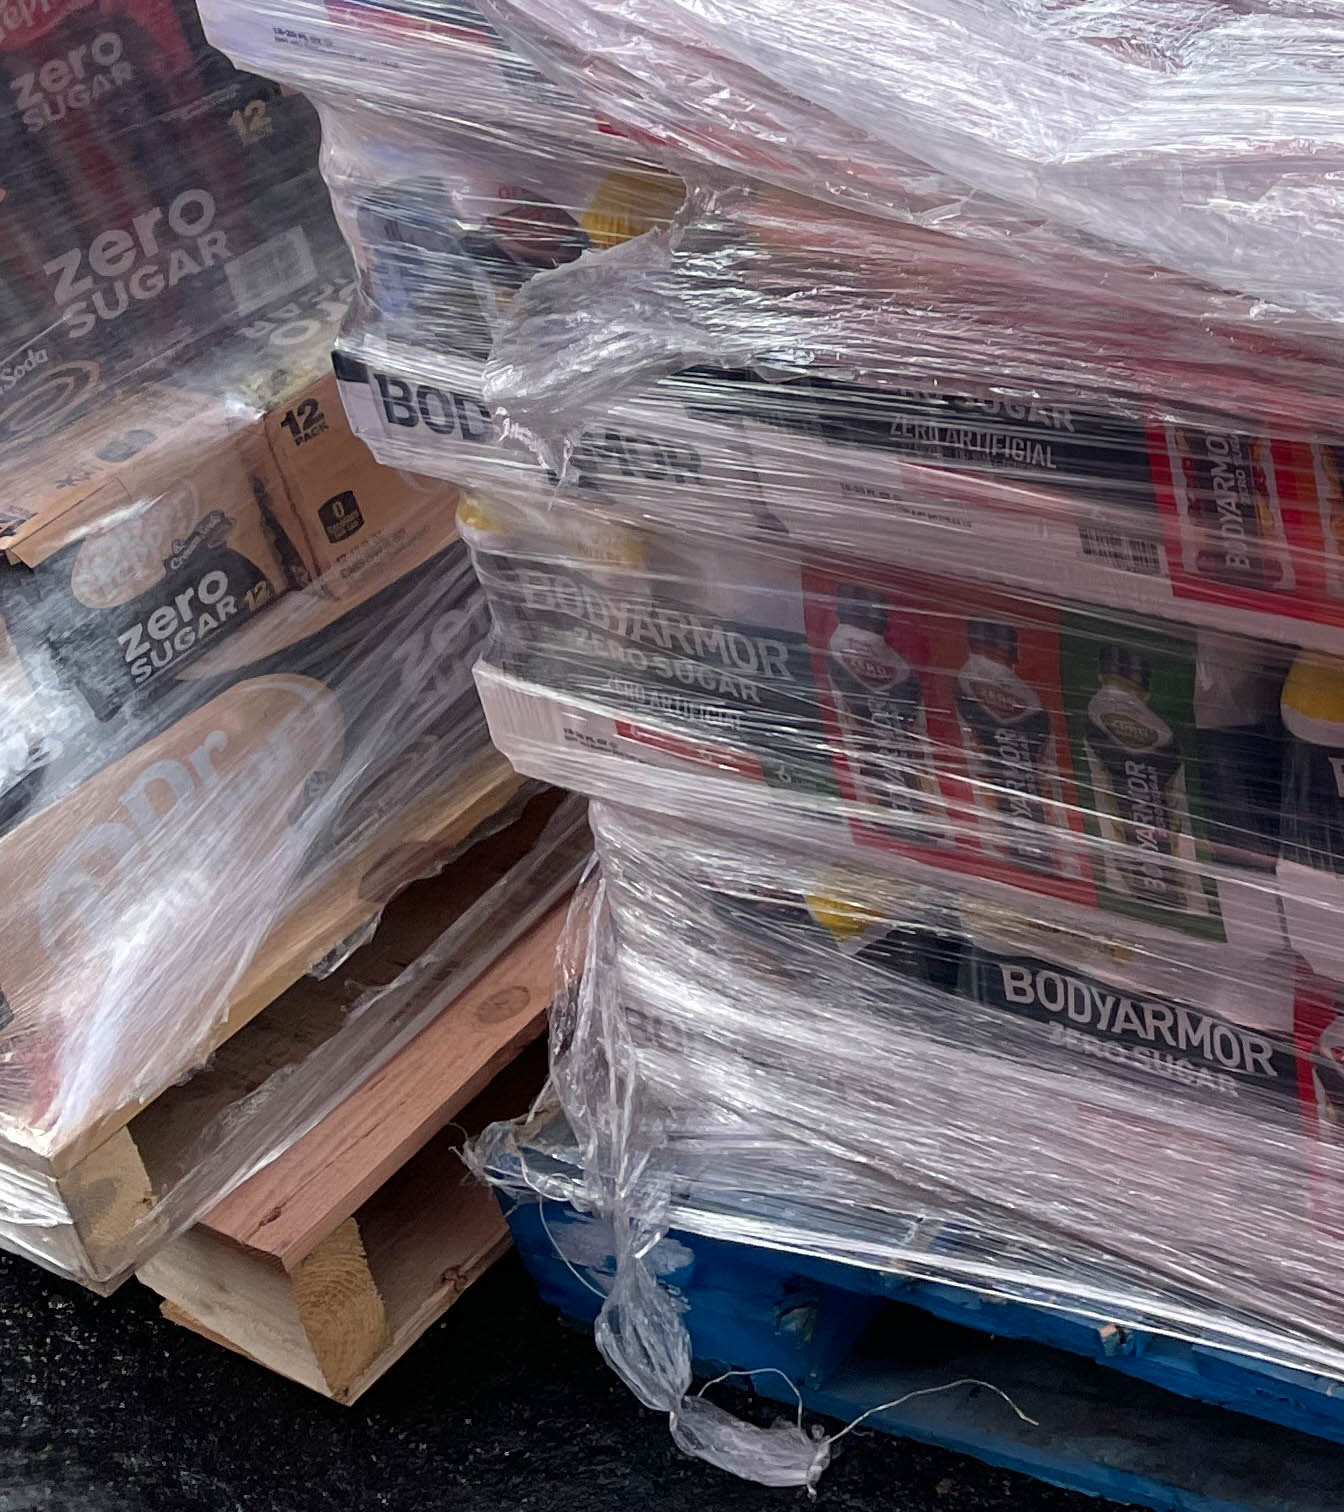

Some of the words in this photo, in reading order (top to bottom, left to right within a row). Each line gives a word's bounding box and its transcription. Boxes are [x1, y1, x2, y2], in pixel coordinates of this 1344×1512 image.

[9, 31, 124, 112] zero
[23, 59, 135, 133] SUGAR
[43, 187, 217, 307] zero
[65, 226, 237, 341] SUGAR
[1, 348, 48, 388] Soda
[280, 397, 326, 437] 12
[295, 422, 330, 448] PACK
[889, 416, 939, 446] ZERO
[942, 422, 1058, 471] ARTIFICIAL
[117, 569, 230, 664] zero
[130, 595, 240, 685] SUGAR
[654, 656, 761, 704] SUGAR
[1003, 965, 1279, 1078] BODYARMOR
[1132, 1044, 1240, 1099] SUGAR
